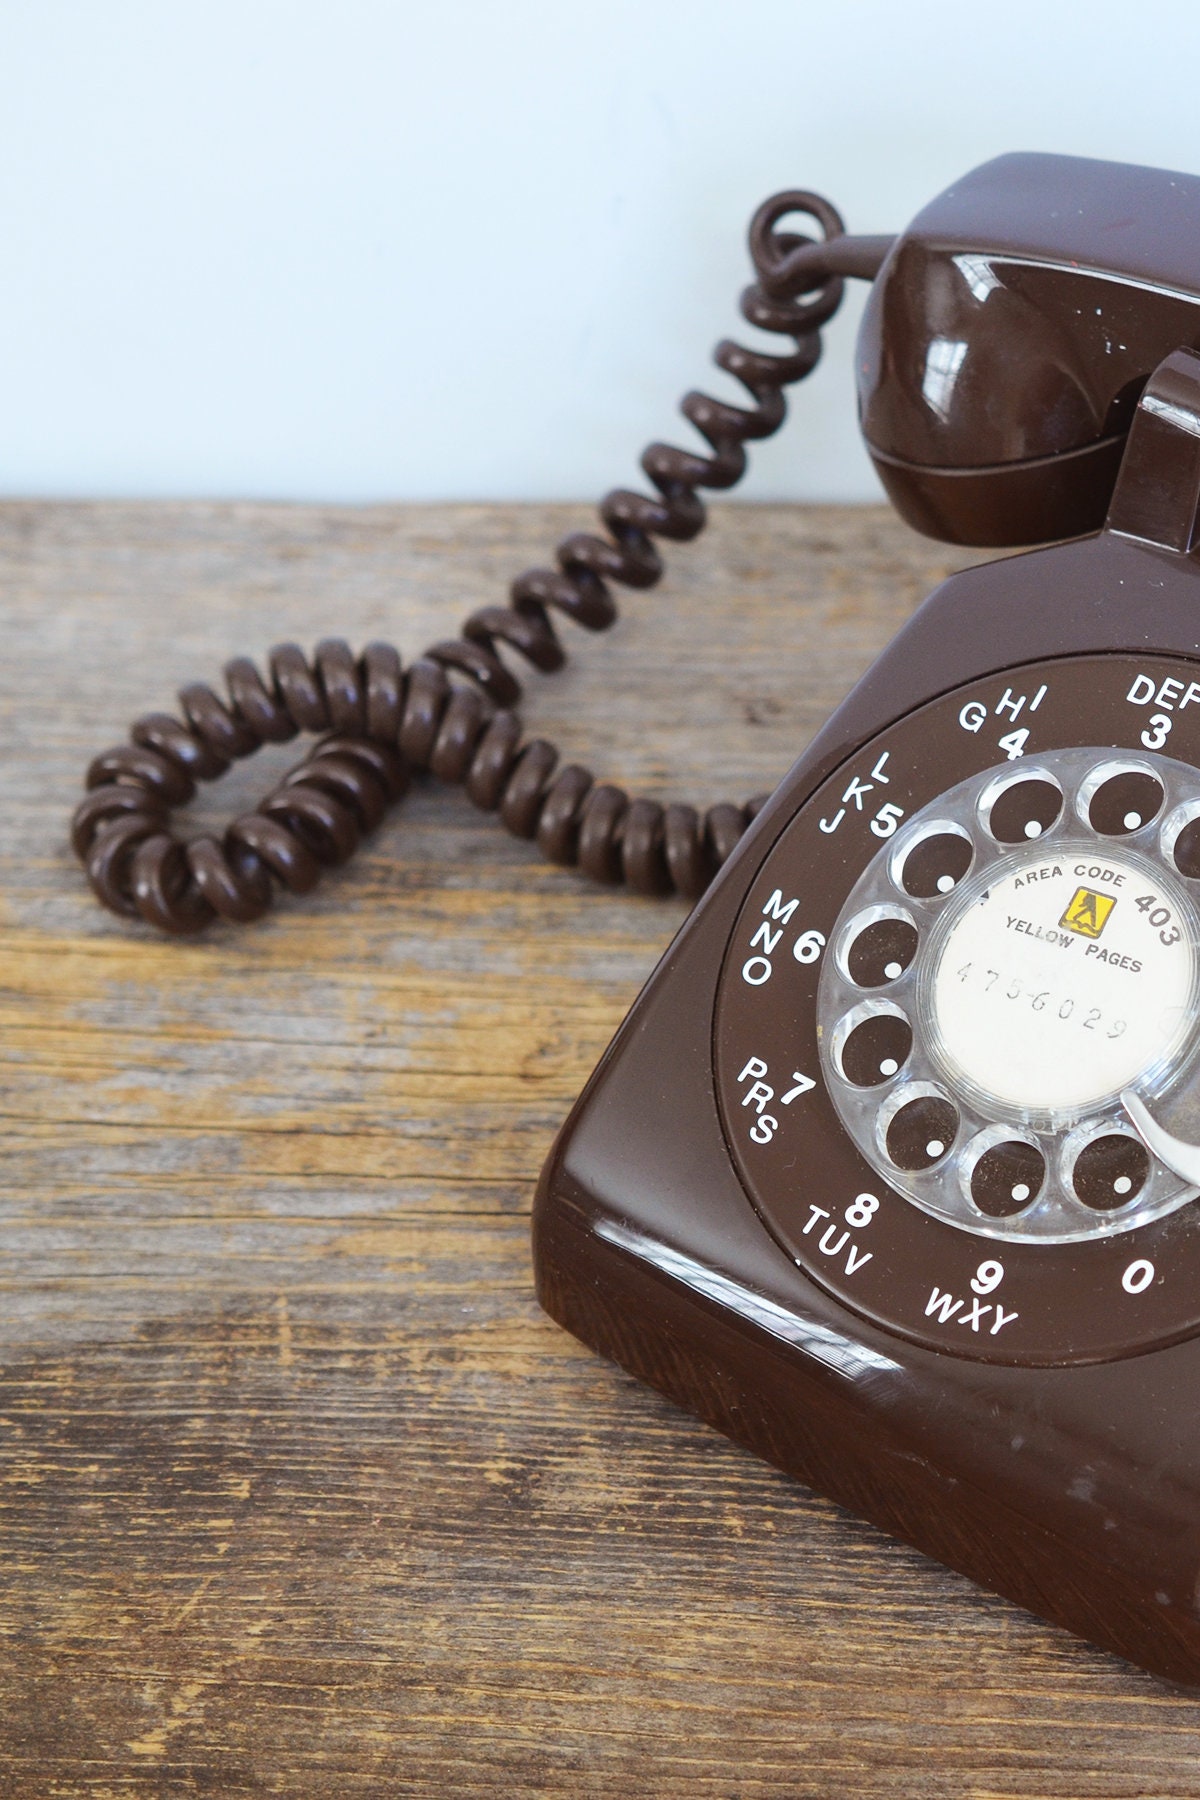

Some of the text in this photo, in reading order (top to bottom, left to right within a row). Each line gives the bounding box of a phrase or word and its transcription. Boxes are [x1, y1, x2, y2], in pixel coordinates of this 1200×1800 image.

[958, 685, 1047, 733] GHI
[998, 728, 1030, 761] 4
[1140, 714, 1172, 750] 3
[870, 803, 904, 838] 5
[1013, 865, 1181, 946] AREA CODE 403
[793, 930, 826, 964] 6
[1006, 916, 1143, 973] YELLOW PAGES
[780, 1072, 816, 1105] 7
[844, 1193, 880, 1228] 8
[802, 1204, 873, 1276] TUV
[970, 1260, 1004, 1295] 9
[924, 1287, 1018, 1336] WXY
